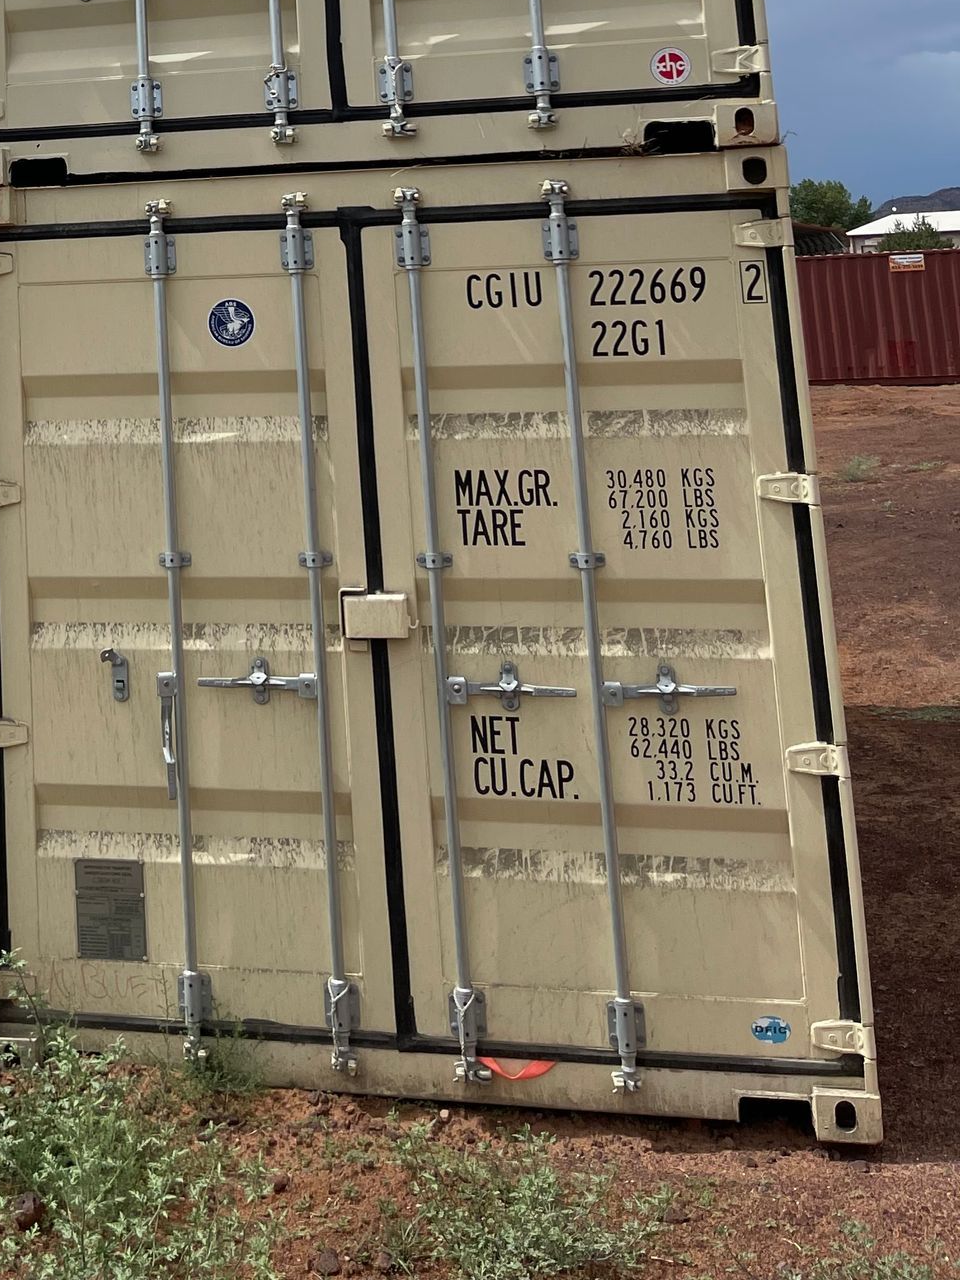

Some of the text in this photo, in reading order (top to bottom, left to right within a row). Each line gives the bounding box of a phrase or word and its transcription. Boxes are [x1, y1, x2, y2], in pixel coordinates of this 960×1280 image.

[466, 263, 764, 309] CGIU 222669 2
[591, 319, 666, 357] 22G1
[454, 469, 558, 507] MAX.GR.
[605, 467, 715, 489] 30,480 KGS
[608, 488, 715, 510] 67,200 LBS
[456, 508, 526, 547] TARE
[621, 508, 720, 530] 2,160 KGS
[623, 528, 720, 550] 4,760 LBS
[470, 715, 520, 755] NET
[628, 716, 741, 740] 28,320 KGS
[630, 737, 740, 762] 62,440 LBS
[474, 756, 579, 800] CU.CAP.
[655, 759, 759, 784] 33.2 CU.M.
[647, 779, 762, 806] 1,173 CU.FT.
[754, 1024, 787, 1034] DFIC
